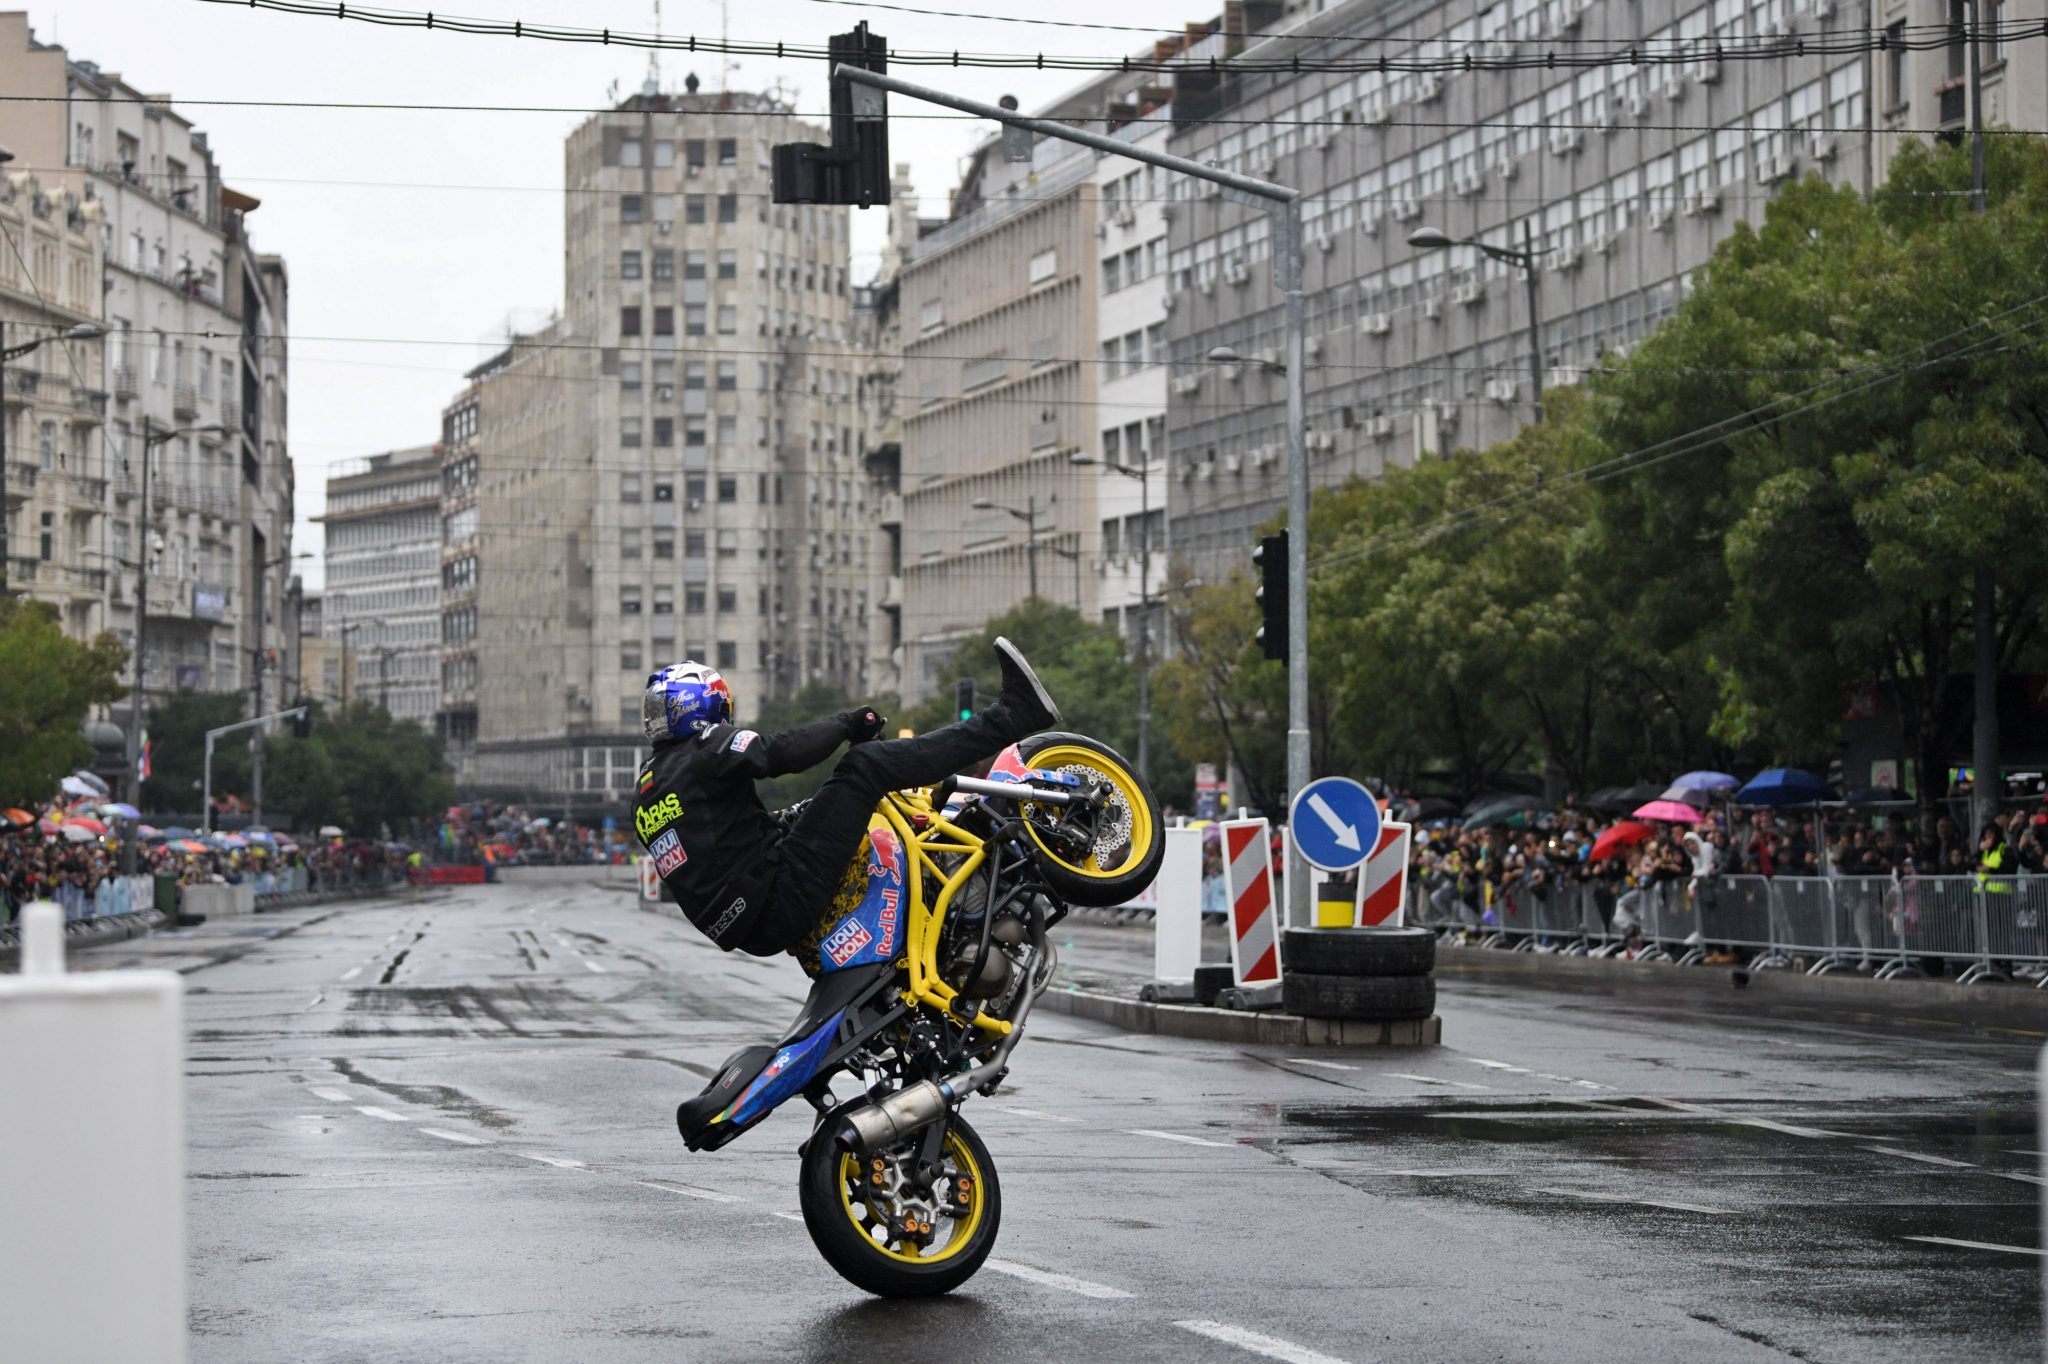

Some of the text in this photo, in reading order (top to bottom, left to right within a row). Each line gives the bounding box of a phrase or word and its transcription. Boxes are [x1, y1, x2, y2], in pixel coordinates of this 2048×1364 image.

[645, 807, 684, 838] FREESTYLE
[650, 833, 678, 860] LIQUI
[657, 846, 684, 875] MOLY
[824, 920, 861, 954] LIQUI
[831, 929, 868, 963] MOLY
